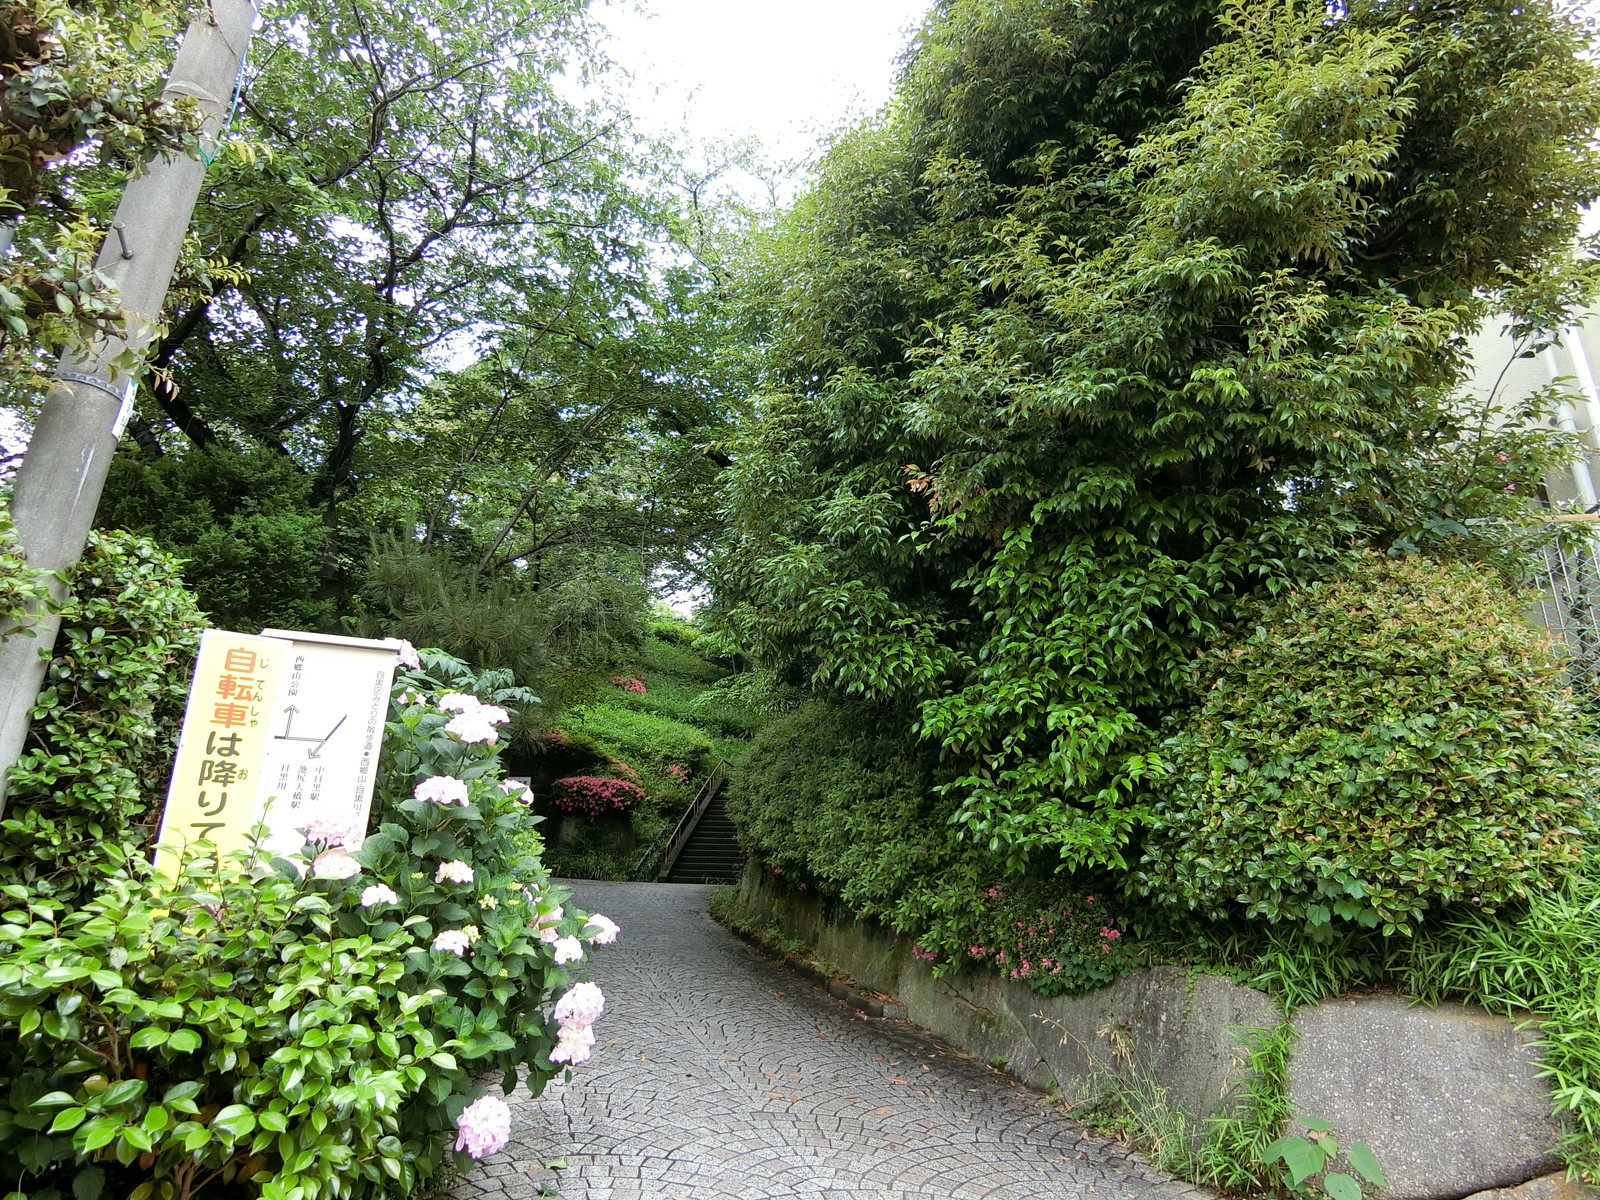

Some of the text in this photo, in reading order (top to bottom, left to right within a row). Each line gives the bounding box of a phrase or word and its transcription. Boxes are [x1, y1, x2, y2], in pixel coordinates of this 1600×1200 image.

[287, 655, 305, 697] 西郷山公園
[276, 763, 290, 791] 目黒川
[290, 764, 308, 809] 池尻大橋駅
[310, 765, 326, 801] 中目黒駅
